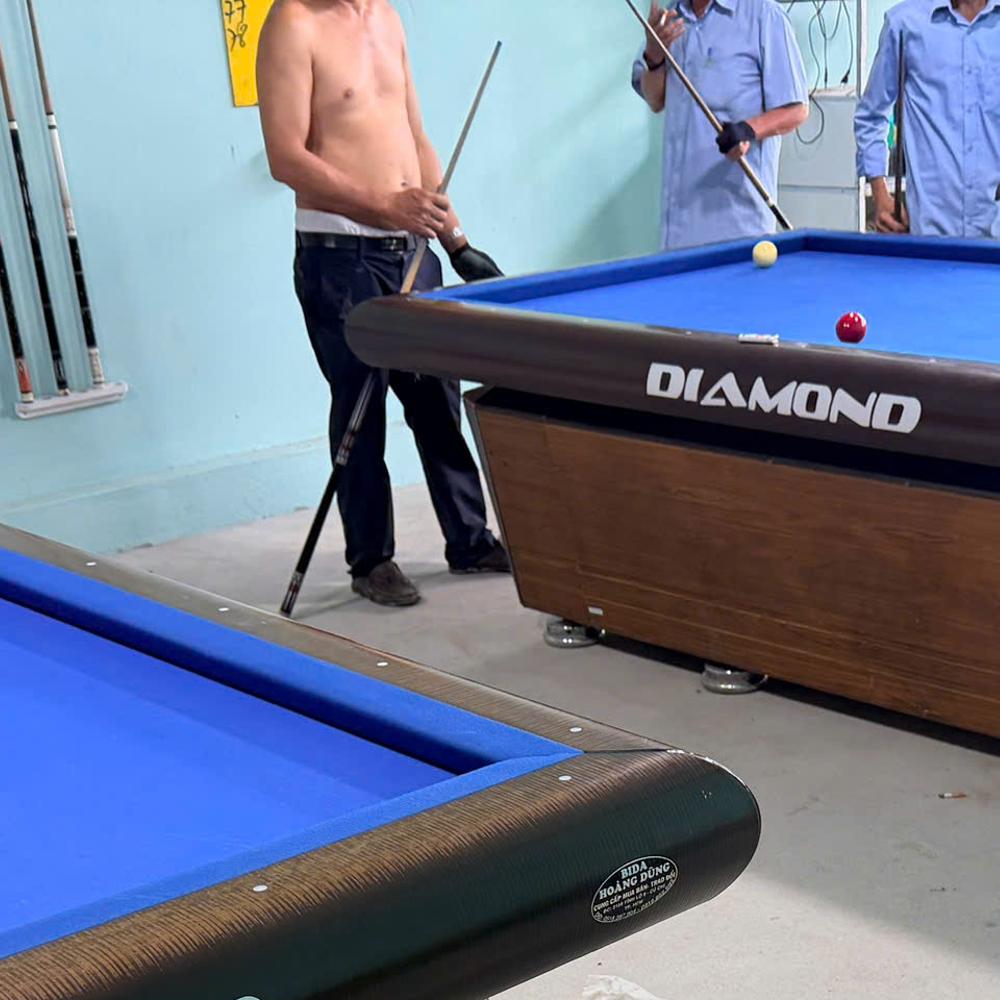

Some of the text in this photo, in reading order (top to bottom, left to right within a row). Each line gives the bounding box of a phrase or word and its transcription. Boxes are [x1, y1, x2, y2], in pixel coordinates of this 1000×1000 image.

[646, 362, 922, 434] DIAMOND
[599, 862, 670, 900] HOÀNG DŨNG
[620, 860, 648, 879] BIDA
